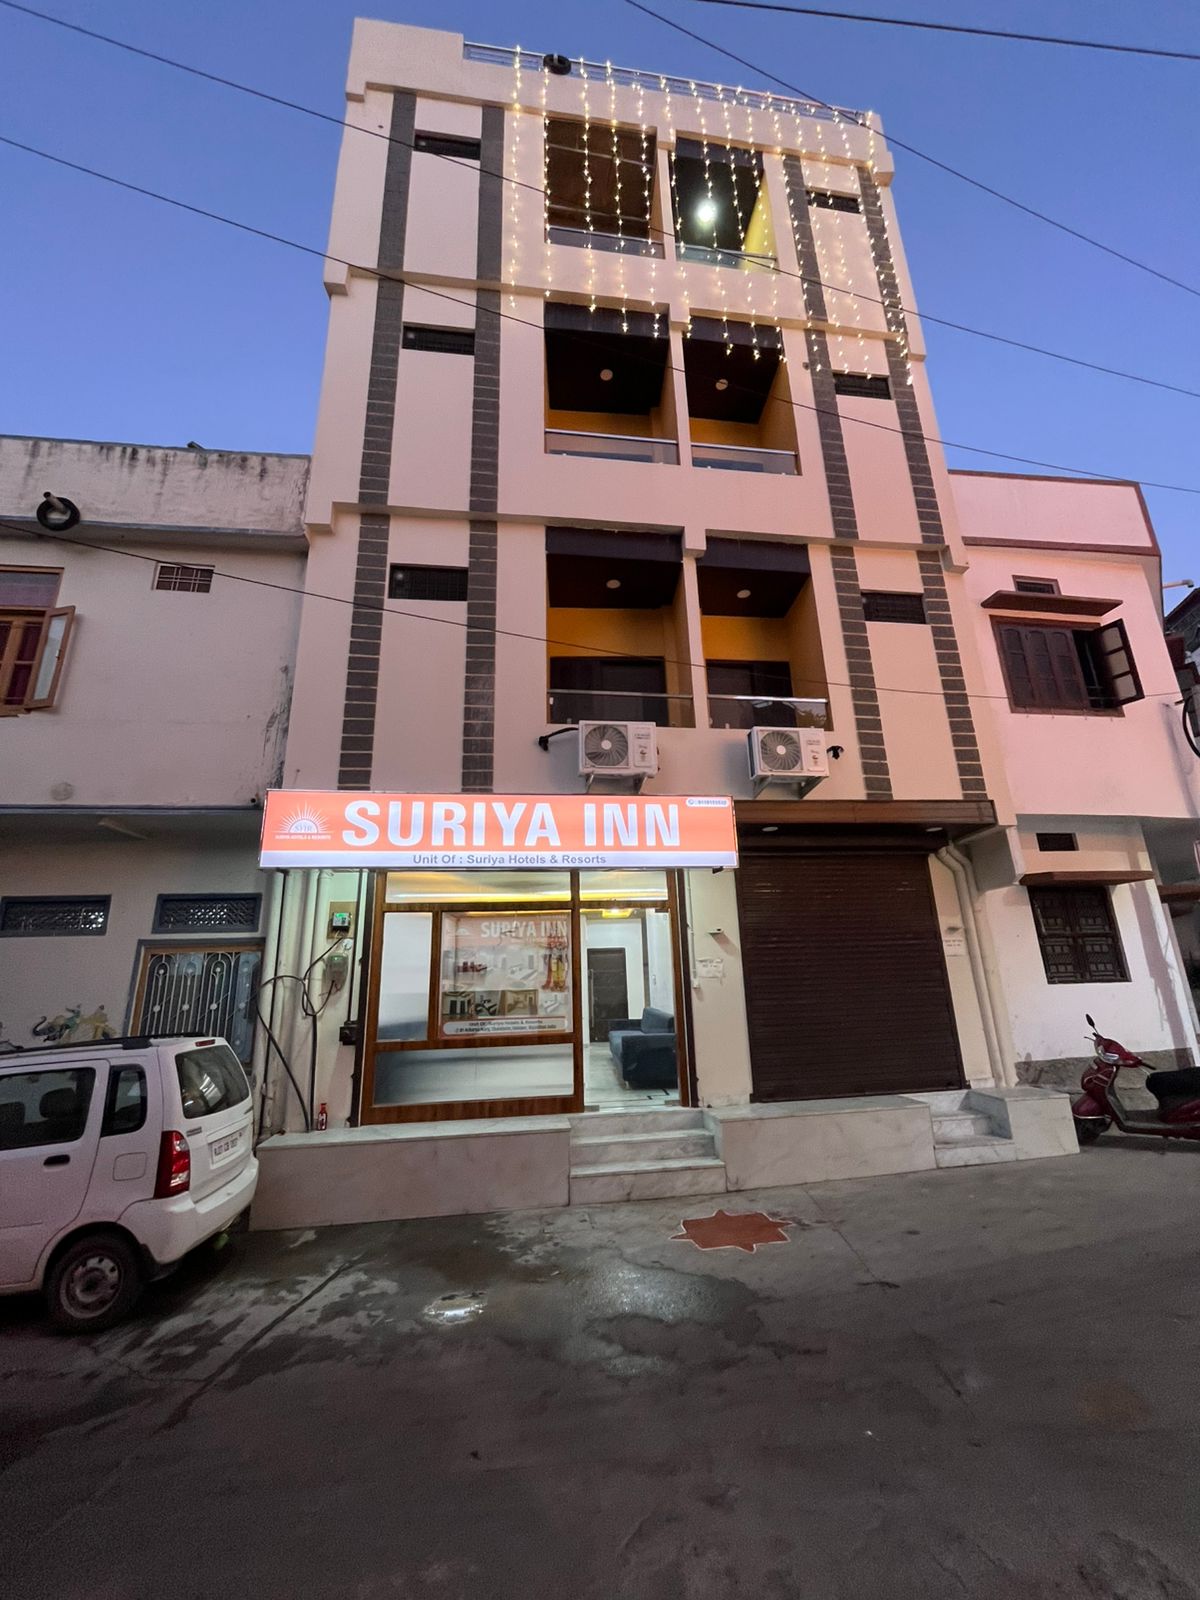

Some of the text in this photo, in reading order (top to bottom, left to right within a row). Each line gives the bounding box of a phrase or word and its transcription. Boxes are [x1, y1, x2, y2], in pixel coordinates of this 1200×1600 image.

[342, 799, 681, 847] SURIYA INN
[413, 854, 438, 865] Unit
[441, 854, 456, 865] Of
[466, 854, 505, 867] Suriya
[509, 854, 546, 865] Hotels
[550, 854, 559, 865] &
[562, 854, 607, 864] Resorts
